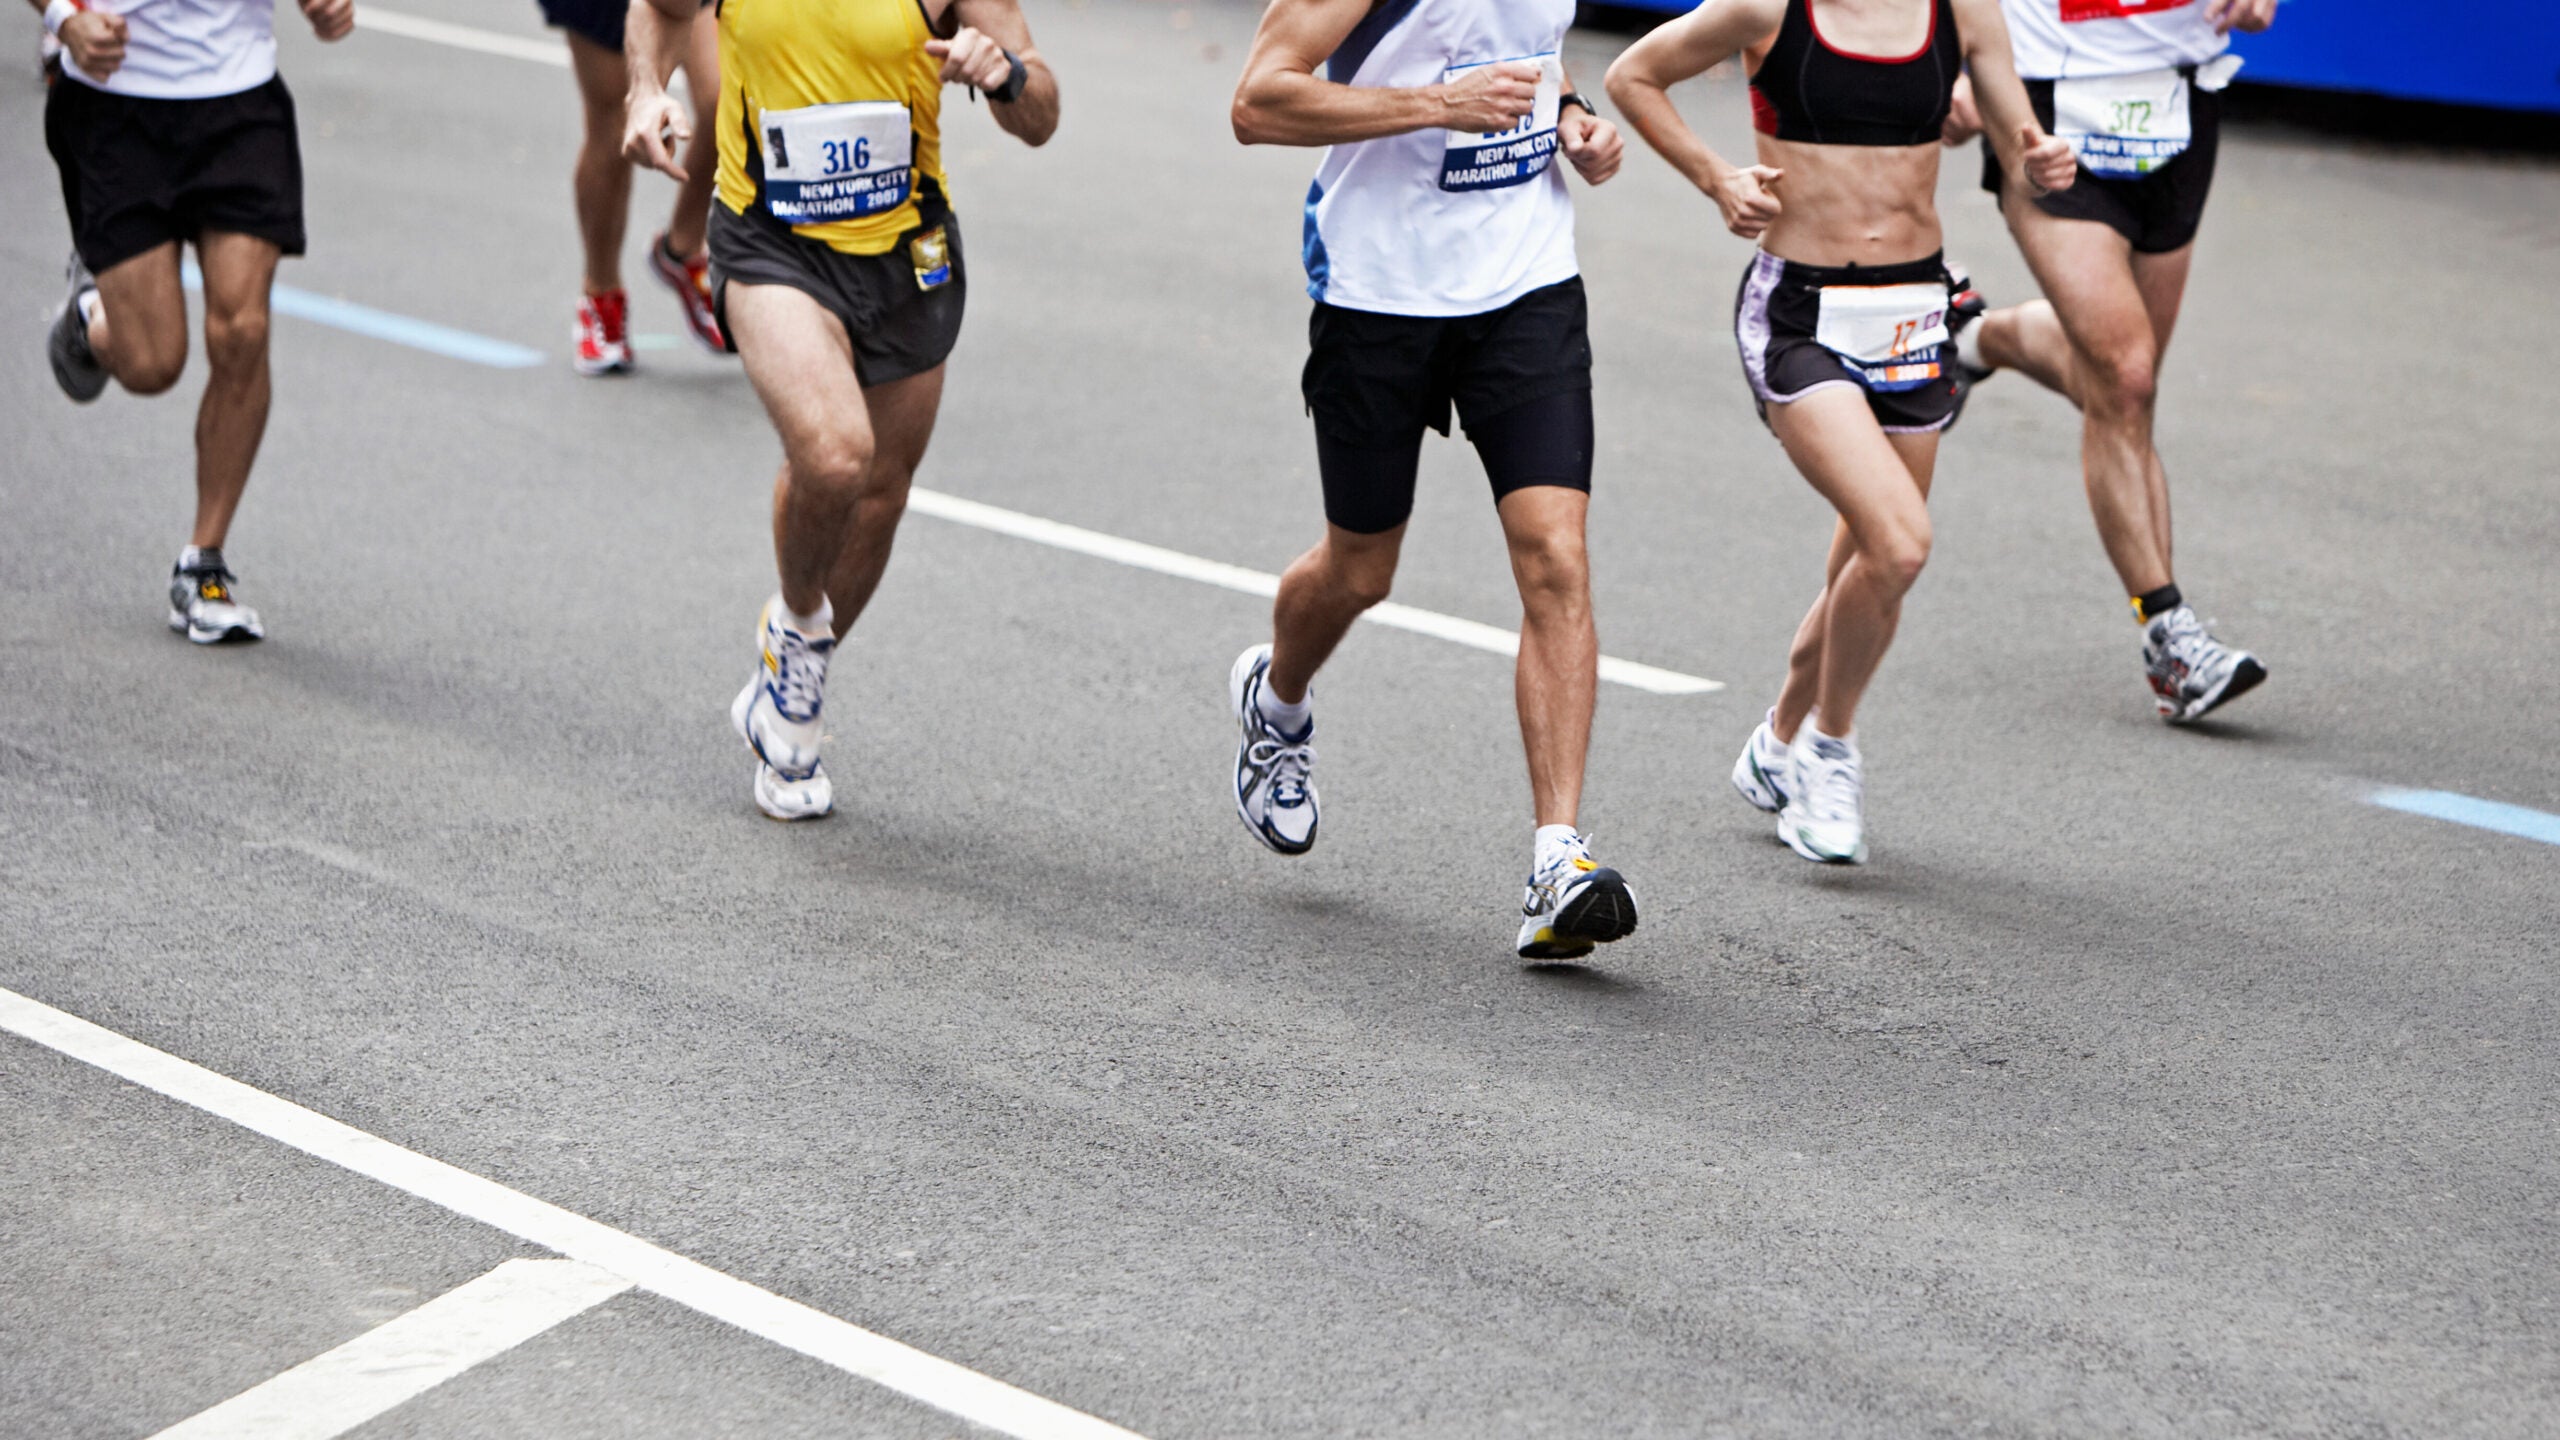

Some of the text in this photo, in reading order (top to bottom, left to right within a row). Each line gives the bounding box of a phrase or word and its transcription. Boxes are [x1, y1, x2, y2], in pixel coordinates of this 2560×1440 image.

[2110, 100, 2152, 133] 372
[822, 136, 870, 175] 316
[1475, 131, 1557, 165] NEW YORK CITY
[800, 169, 908, 200] NEW YORK CITY
[1445, 162, 1518, 184] MARATHON
[772, 189, 899, 217] MARATHON 2007
